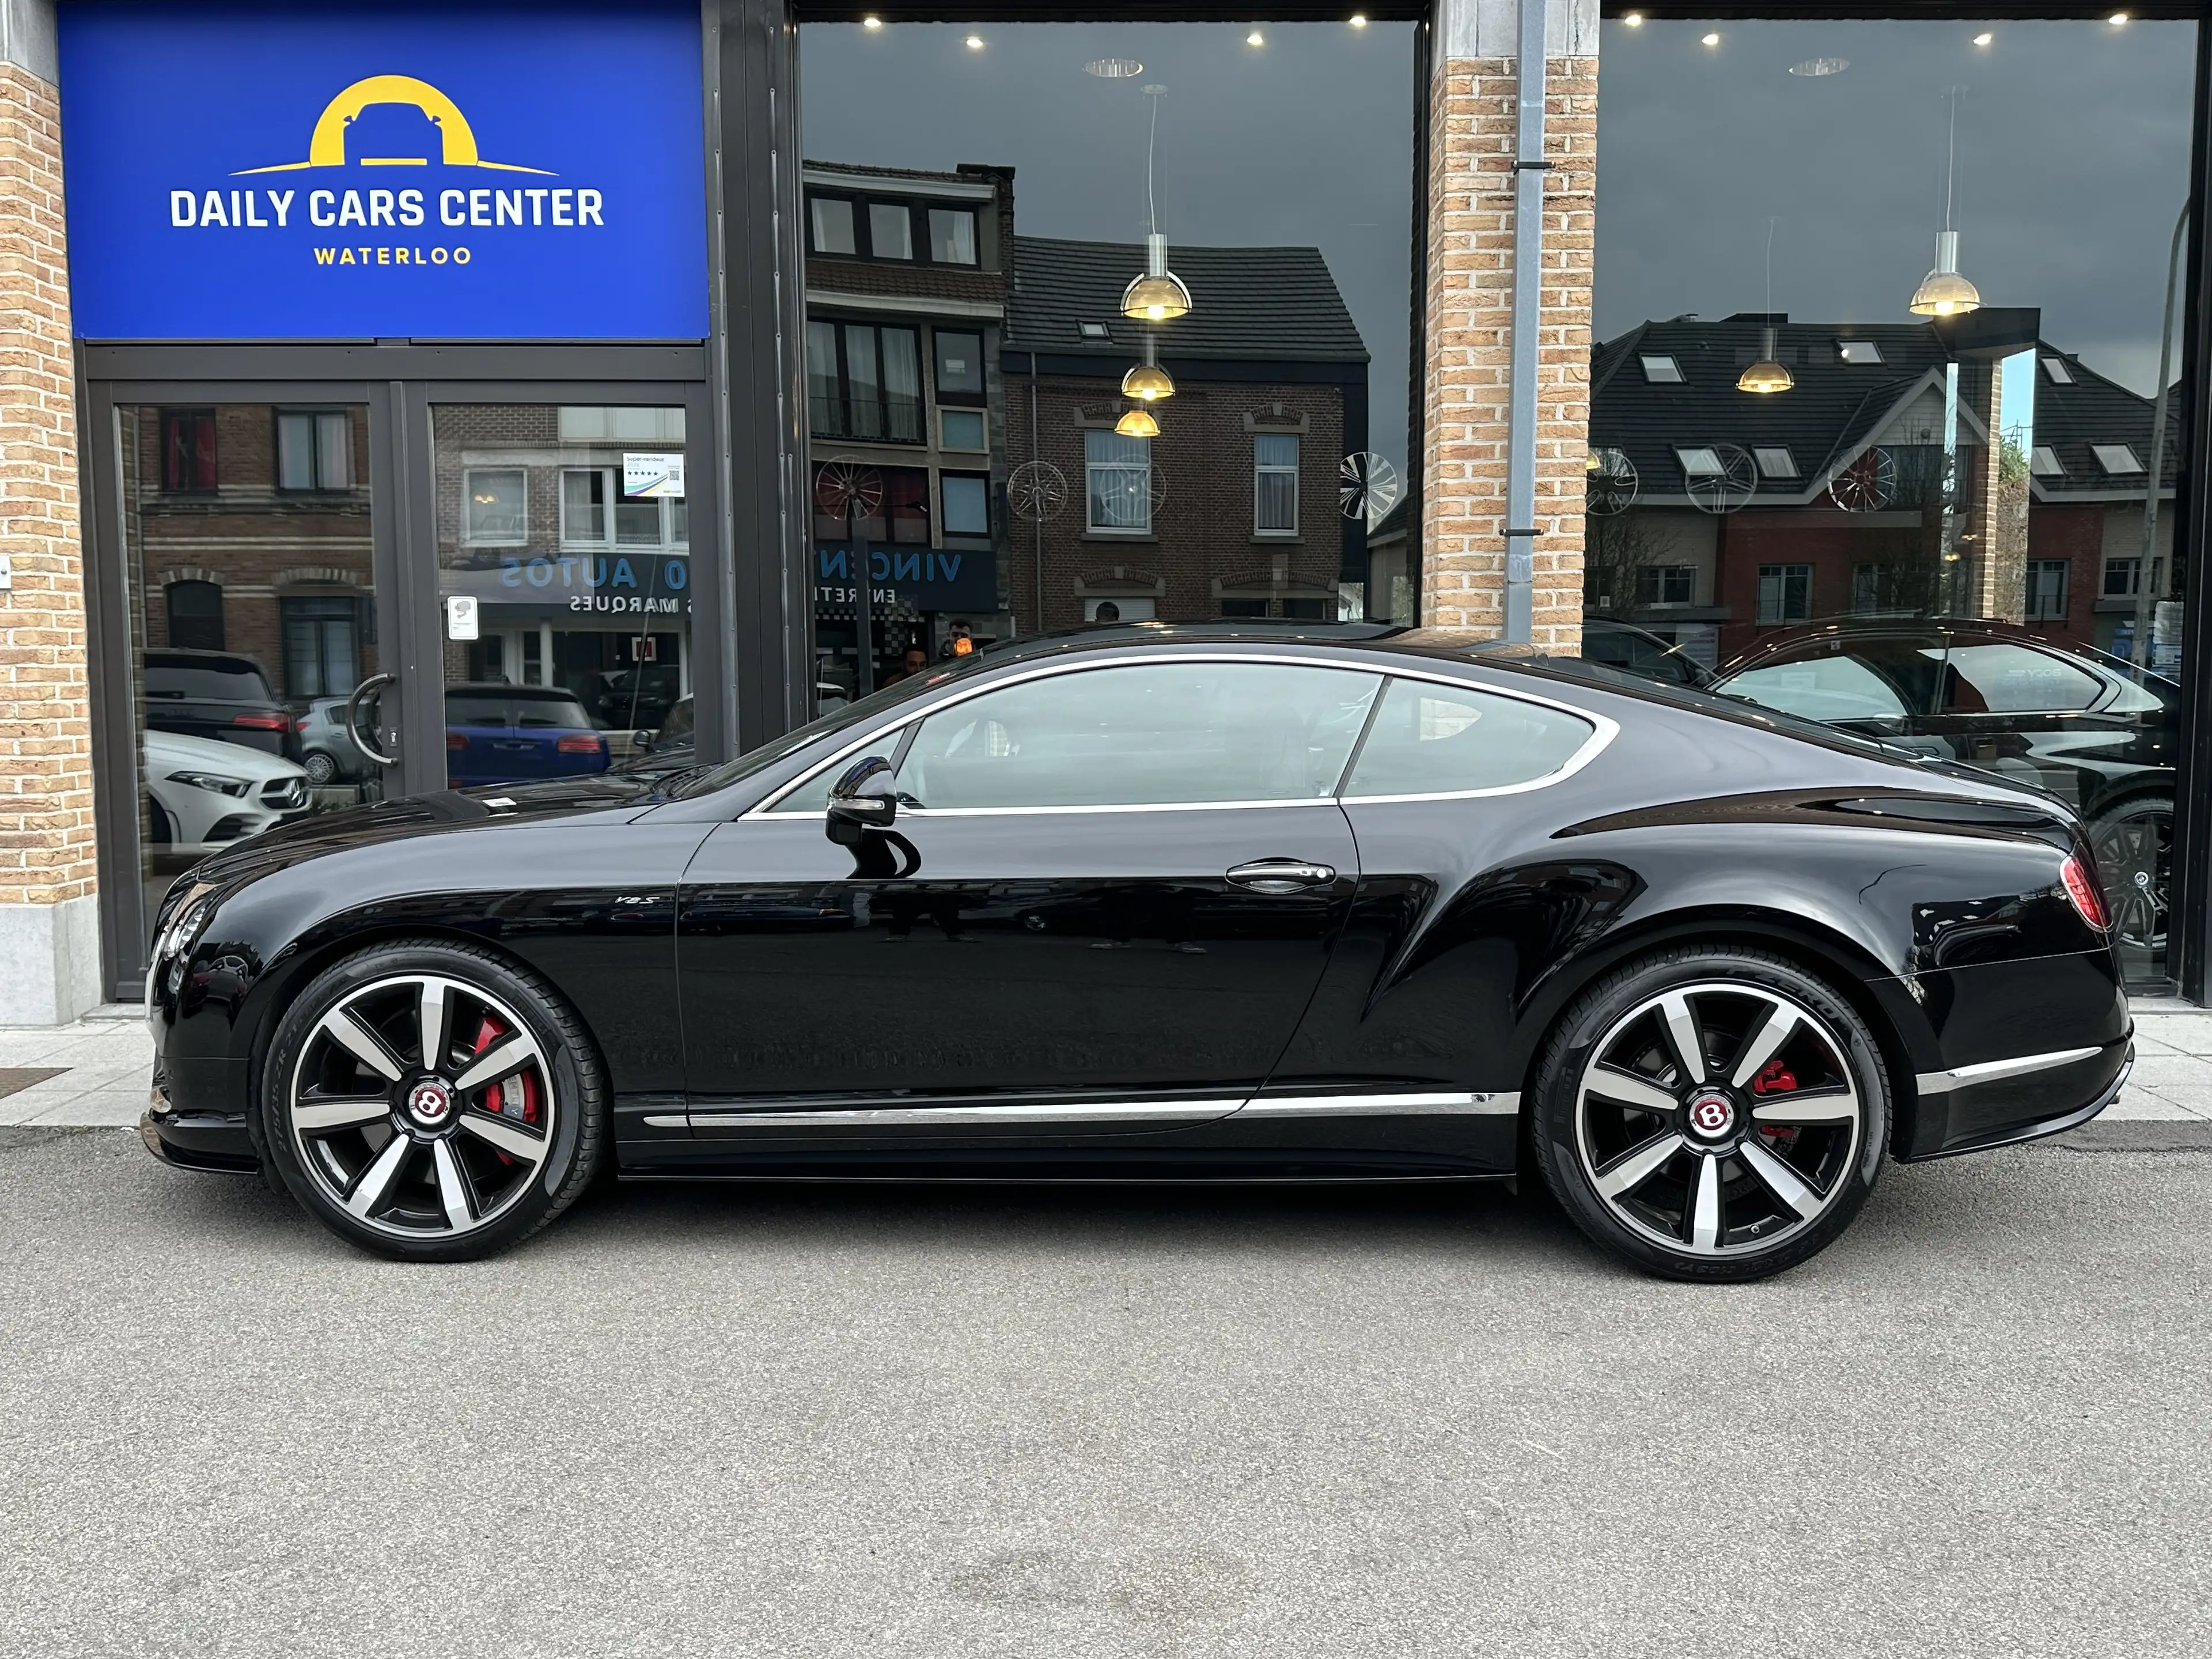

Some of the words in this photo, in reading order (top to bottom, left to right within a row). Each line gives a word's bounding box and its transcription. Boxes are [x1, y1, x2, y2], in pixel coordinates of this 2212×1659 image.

[170, 189, 296, 228] DAILY
[309, 189, 425, 227] CARS
[440, 188, 605, 227] CENTER
[313, 247, 471, 265] WATERLOO
[418, 1091, 442, 1114] B
[1699, 1104, 1724, 1127] B
